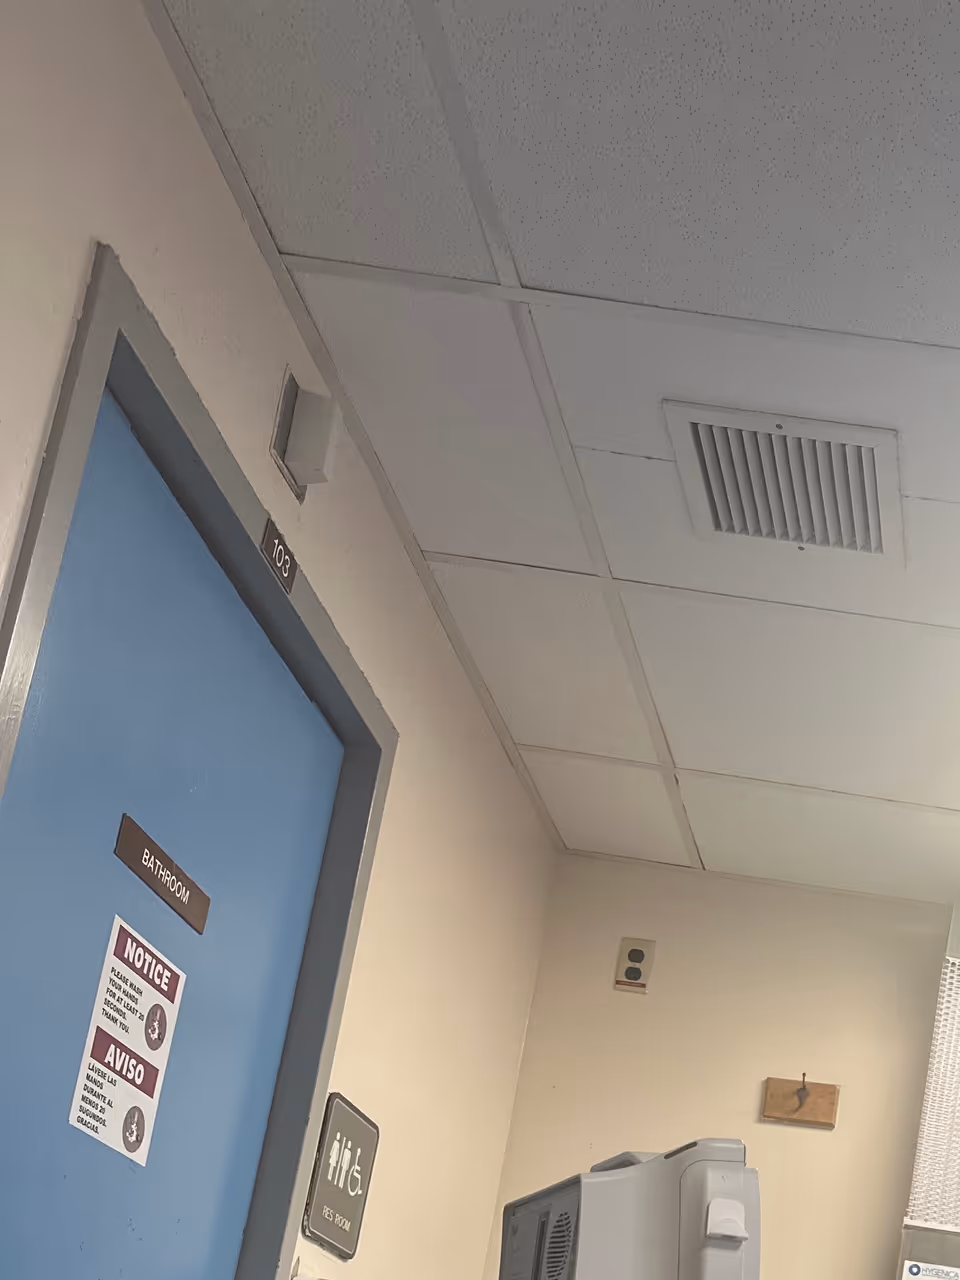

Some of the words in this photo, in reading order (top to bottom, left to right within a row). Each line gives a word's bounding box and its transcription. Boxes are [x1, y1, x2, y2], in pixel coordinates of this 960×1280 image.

[272, 539, 290, 577] 103
[142, 848, 190, 904] BATHROOM
[124, 937, 172, 992] NOTICE
[108, 977, 122, 991] YOUR
[122, 986, 138, 1005] HANDS
[110, 966, 128, 986] PLEASE
[129, 981, 143, 996] WASH
[104, 998, 128, 1020] SECONDS.
[106, 987, 116, 1000] FOR
[116, 994, 122, 1005] AT
[124, 998, 138, 1016] LEAST
[138, 1013, 144, 1022] 20
[102, 1008, 118, 1026] THANK
[120, 1020, 130, 1034] YOU.
[104, 1044, 144, 1085] AVISO
[86, 1073, 104, 1090] MANOS
[108, 1076, 117, 1086] LAS
[81, 1094, 98, 1110] MENOS
[98, 1106, 106, 1114] 20
[83, 1084, 106, 1103] DURANTE
[106, 1099, 114, 1108] AL
[76, 1116, 100, 1134] GRACIAS.
[334, 1213, 350, 1232] ROOM
[922, 1268, 960, 1278] HYGENICA
